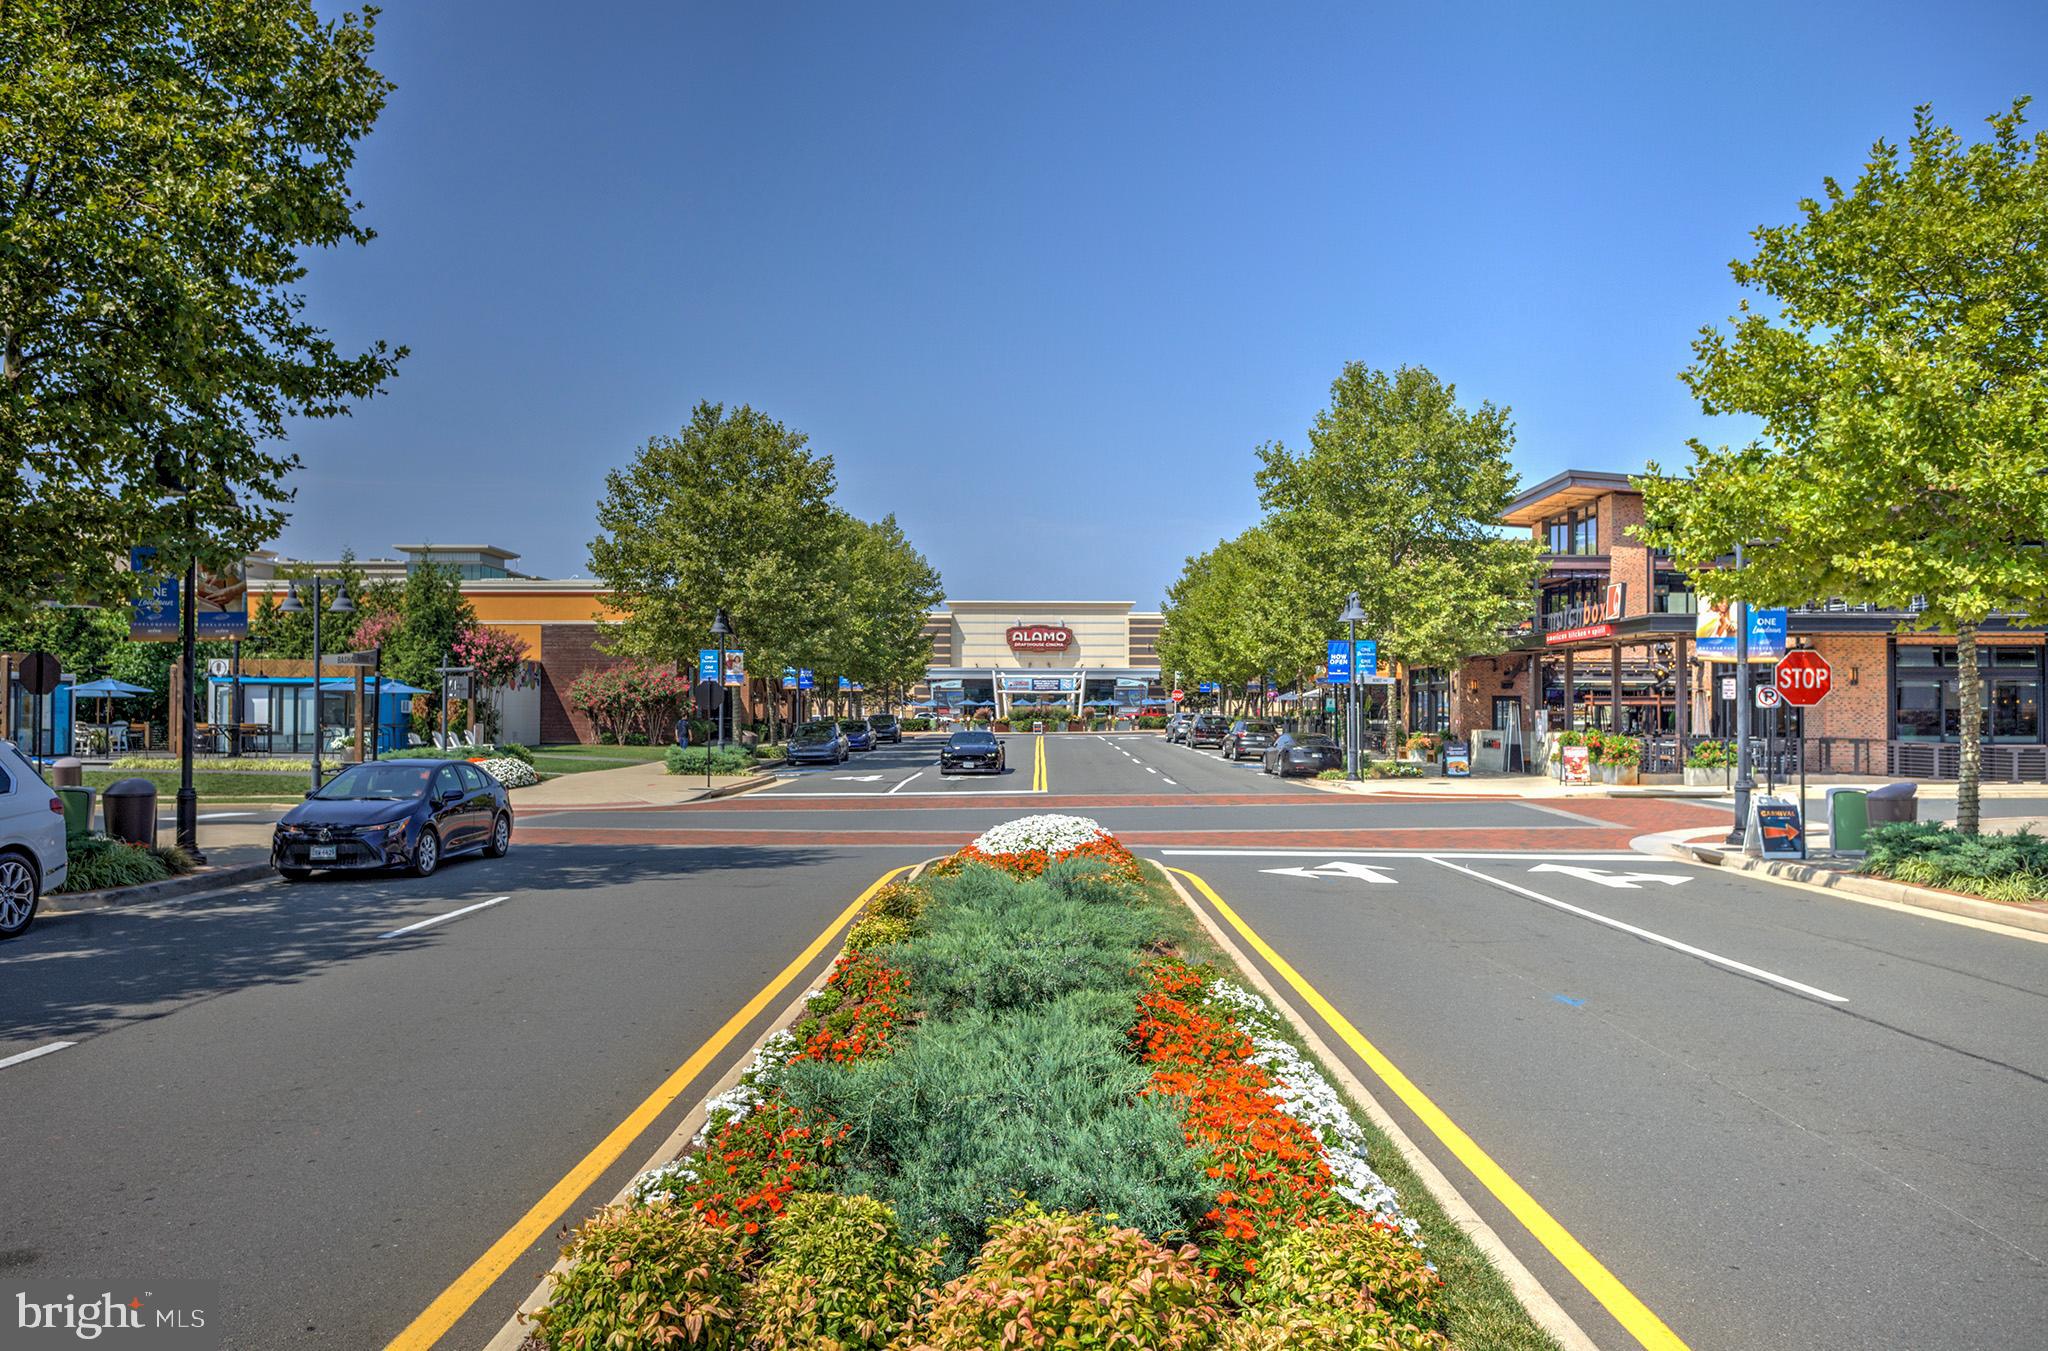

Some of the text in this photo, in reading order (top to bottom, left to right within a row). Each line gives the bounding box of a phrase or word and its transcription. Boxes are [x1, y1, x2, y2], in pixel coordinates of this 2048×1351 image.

[147, 587, 168, 597] NE
[1548, 600, 1607, 633] matchbox
[1756, 618, 1776, 626] ONE
[1012, 631, 1066, 641] ALAMO
[1779, 668, 1829, 689] STOP
